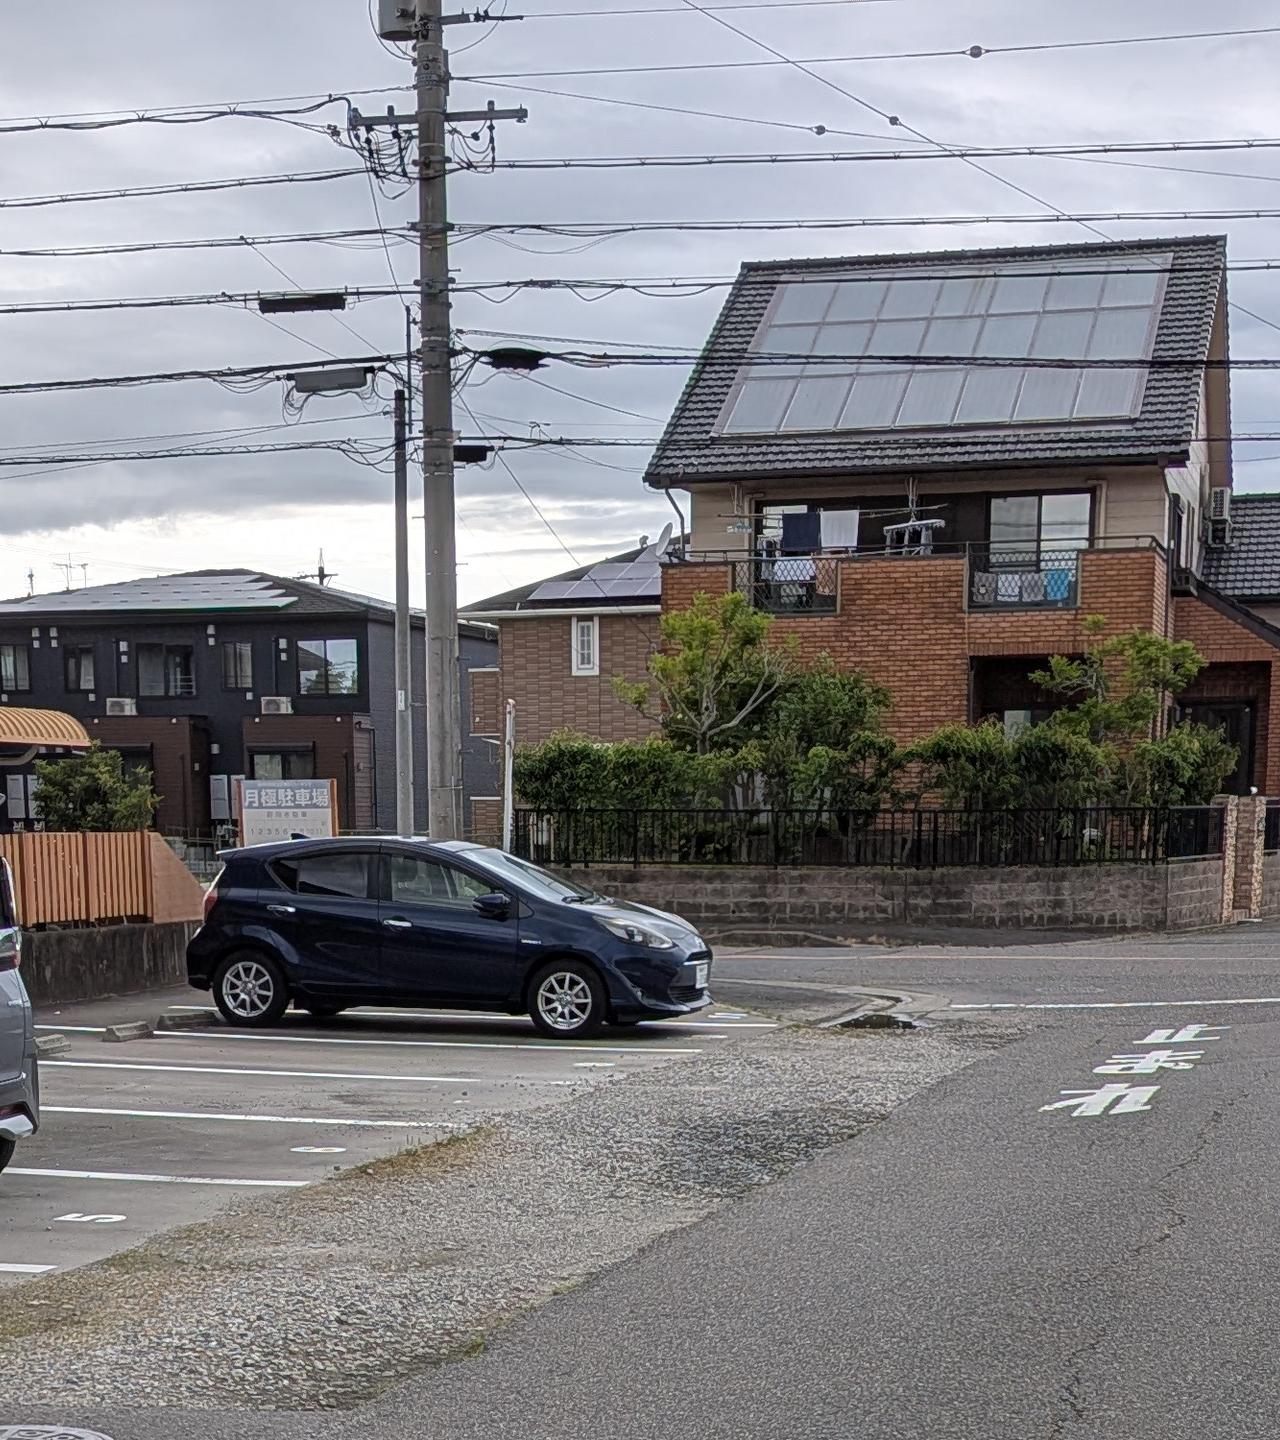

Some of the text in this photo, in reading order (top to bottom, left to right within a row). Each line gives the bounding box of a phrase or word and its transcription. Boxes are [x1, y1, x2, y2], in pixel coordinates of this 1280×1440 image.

[245, 788, 329, 807] 月極駐車場
[1038, 1024, 1231, 1117] 止まれ
[53, 1212, 127, 1223] 5
